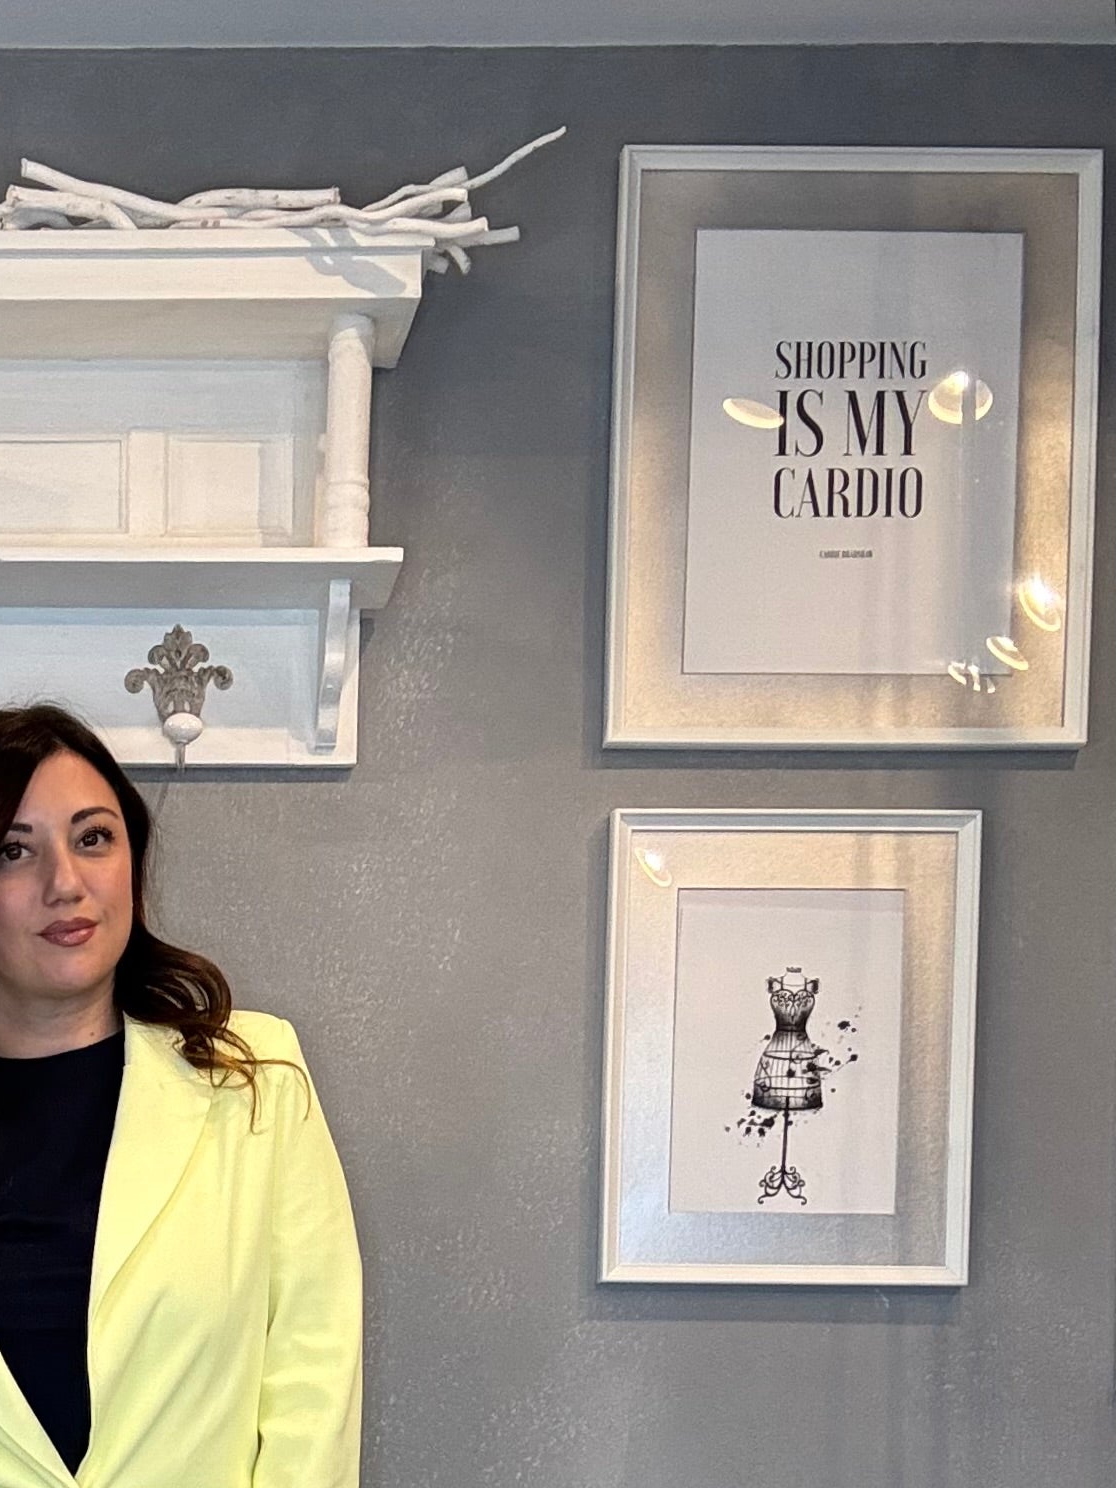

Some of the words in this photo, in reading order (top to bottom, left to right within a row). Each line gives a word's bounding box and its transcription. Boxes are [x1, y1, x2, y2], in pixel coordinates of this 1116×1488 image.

[774, 340, 928, 380] SHOPPING
[773, 388, 825, 457] IS
[842, 389, 929, 457] MY
[772, 466, 924, 519] CARDIO
